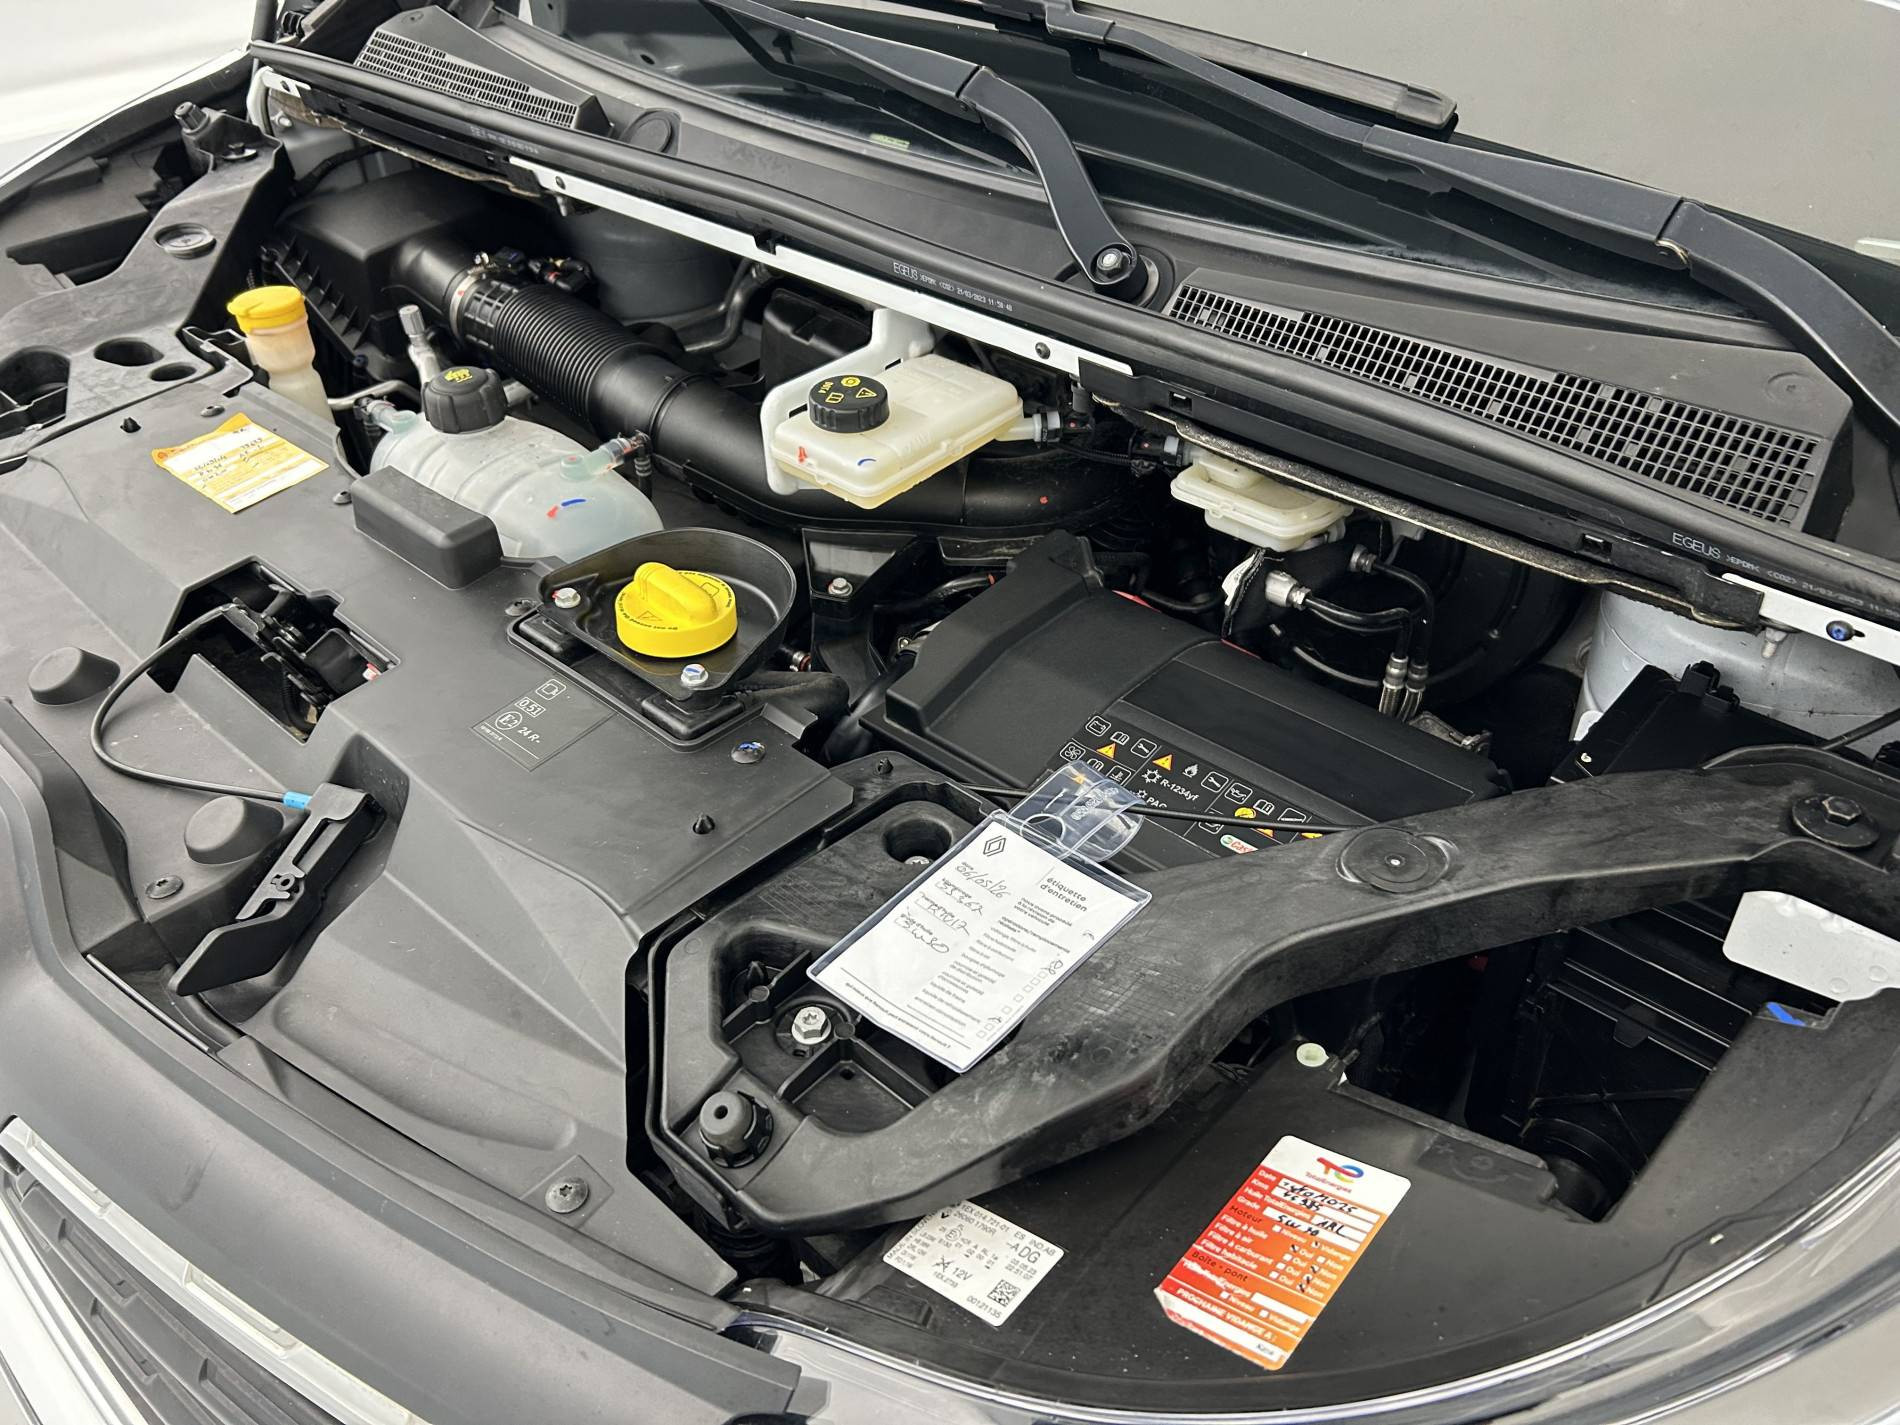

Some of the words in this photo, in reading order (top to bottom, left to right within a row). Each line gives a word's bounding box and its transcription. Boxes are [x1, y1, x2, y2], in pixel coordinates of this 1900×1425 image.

[893, 262, 918, 280] EGEUS
[1672, 531, 1721, 560] EGEUS
[518, 699, 542, 716] 0,51
[1160, 779, 1199, 800] R-1234yf
[1039, 884, 1088, 911] d'entretien
[1045, 877, 1087, 902] étiquette
[1257, 1170, 1277, 1181] Date
[1305, 1171, 1351, 1194] TotalEnergies
[1236, 1195, 1261, 1210] Grade
[1243, 1187, 1263, 1199] Huile
[1229, 1205, 1262, 1224] Moteur
[1013, 1231, 1025, 1240] ES
[1220, 1214, 1241, 1227] Filtre
[1248, 1226, 1268, 1239] huile
[1299, 1248, 1314, 1258] Oui
[1325, 1259, 1344, 1271] Non
[1280, 1228, 1307, 1243] Niveau
[1320, 1244, 1351, 1262] Vidange
[1018, 1246, 1041, 1264] DG
[1207, 1231, 1229, 1244] Filtre
[1235, 1242, 1273, 1265] carburant
[1285, 1266, 1301, 1276] Oui
[1312, 1277, 1330, 1290] Non
[1214, 1222, 1235, 1235] Filtre
[1292, 1257, 1307, 1267] Oui
[1319, 1268, 1337, 1280] Non
[950, 1266, 973, 1281] 12V
[1200, 1239, 1222, 1253] Filtre
[1222, 1248, 1257, 1270] habitacle
[1278, 1274, 1294, 1285] Oui
[1305, 1286, 1324, 1299] Non
[1223, 1267, 1248, 1283] pont
[1176, 1287, 1225, 1317] PROCHAINE
[1226, 1311, 1261, 1336] VIDANGE
[1268, 1313, 1300, 1335] Vidange
